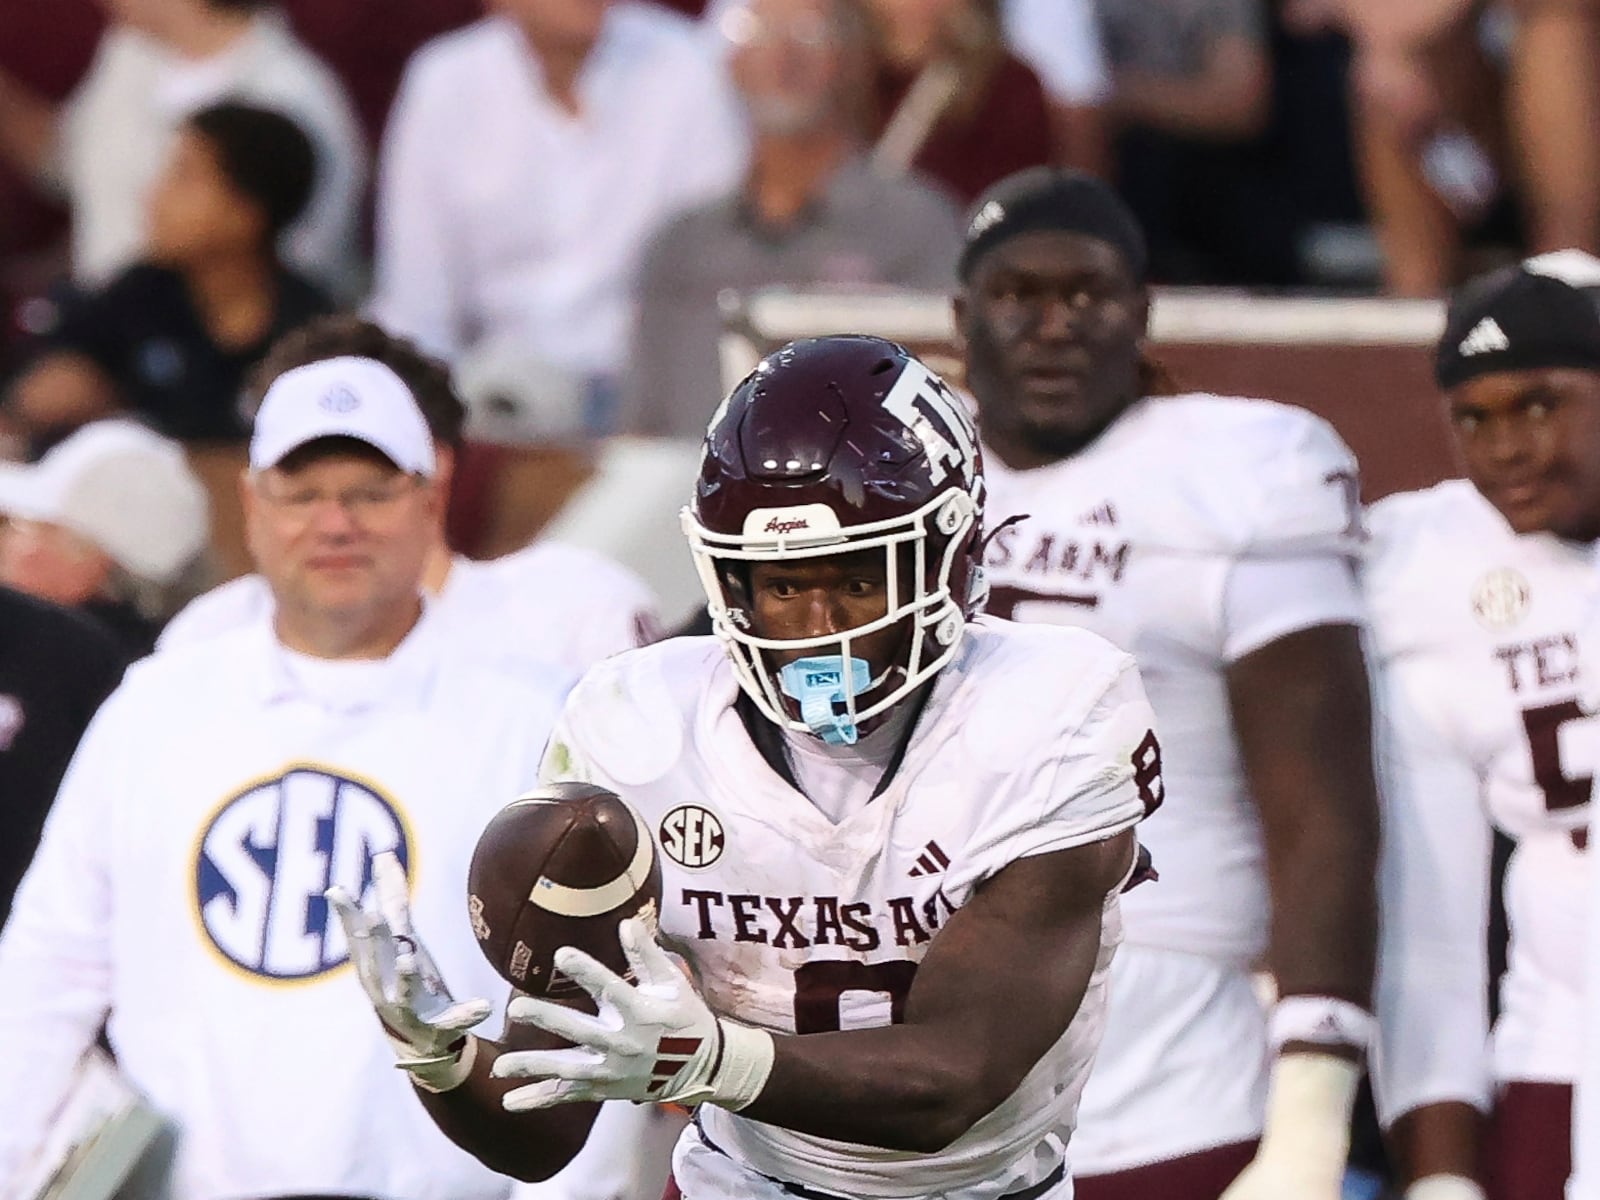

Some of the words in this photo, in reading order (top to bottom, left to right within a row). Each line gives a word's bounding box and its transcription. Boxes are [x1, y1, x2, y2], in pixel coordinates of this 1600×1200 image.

[1131, 728, 1165, 818] 8
[196, 768, 408, 972] SEC
[660, 805, 725, 867] SEC
[682, 889, 880, 951] TEXAS
